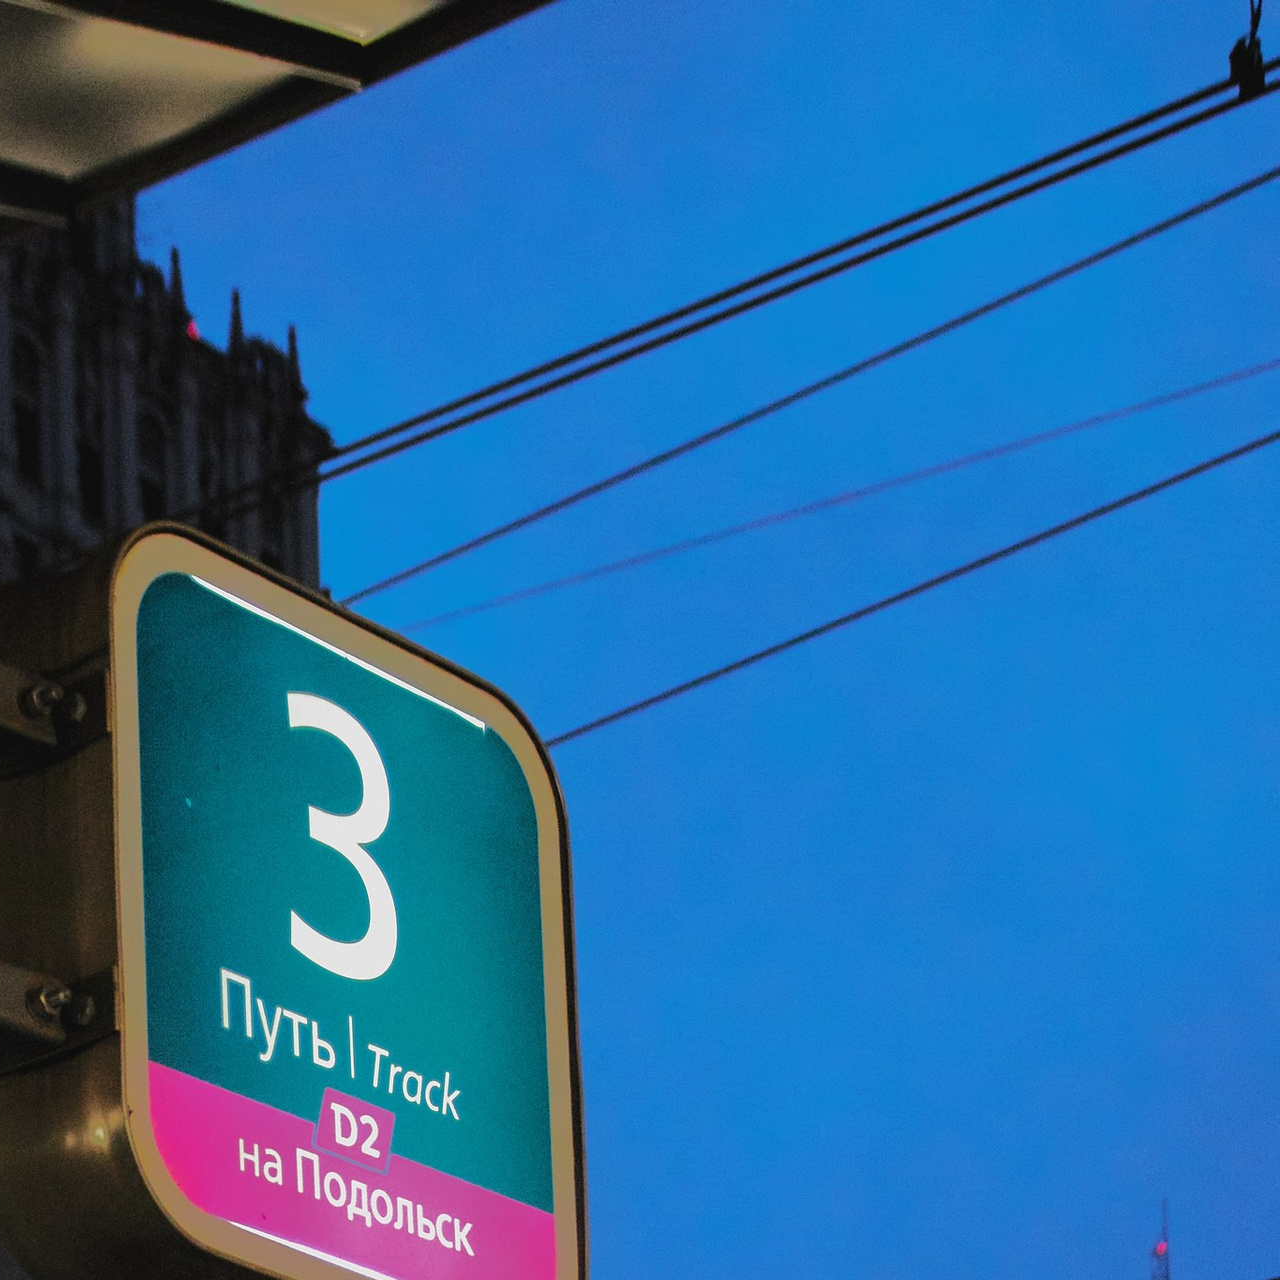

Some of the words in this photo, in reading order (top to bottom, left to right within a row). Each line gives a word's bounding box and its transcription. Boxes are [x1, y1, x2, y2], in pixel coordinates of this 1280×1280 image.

[287, 692, 399, 981] 3
[220, 967, 336, 1069] Путь
[366, 1042, 461, 1121] Track
[238, 1138, 283, 1186] на
[295, 1147, 475, 1257] Подольск
[330, 1102, 381, 1159] D2
